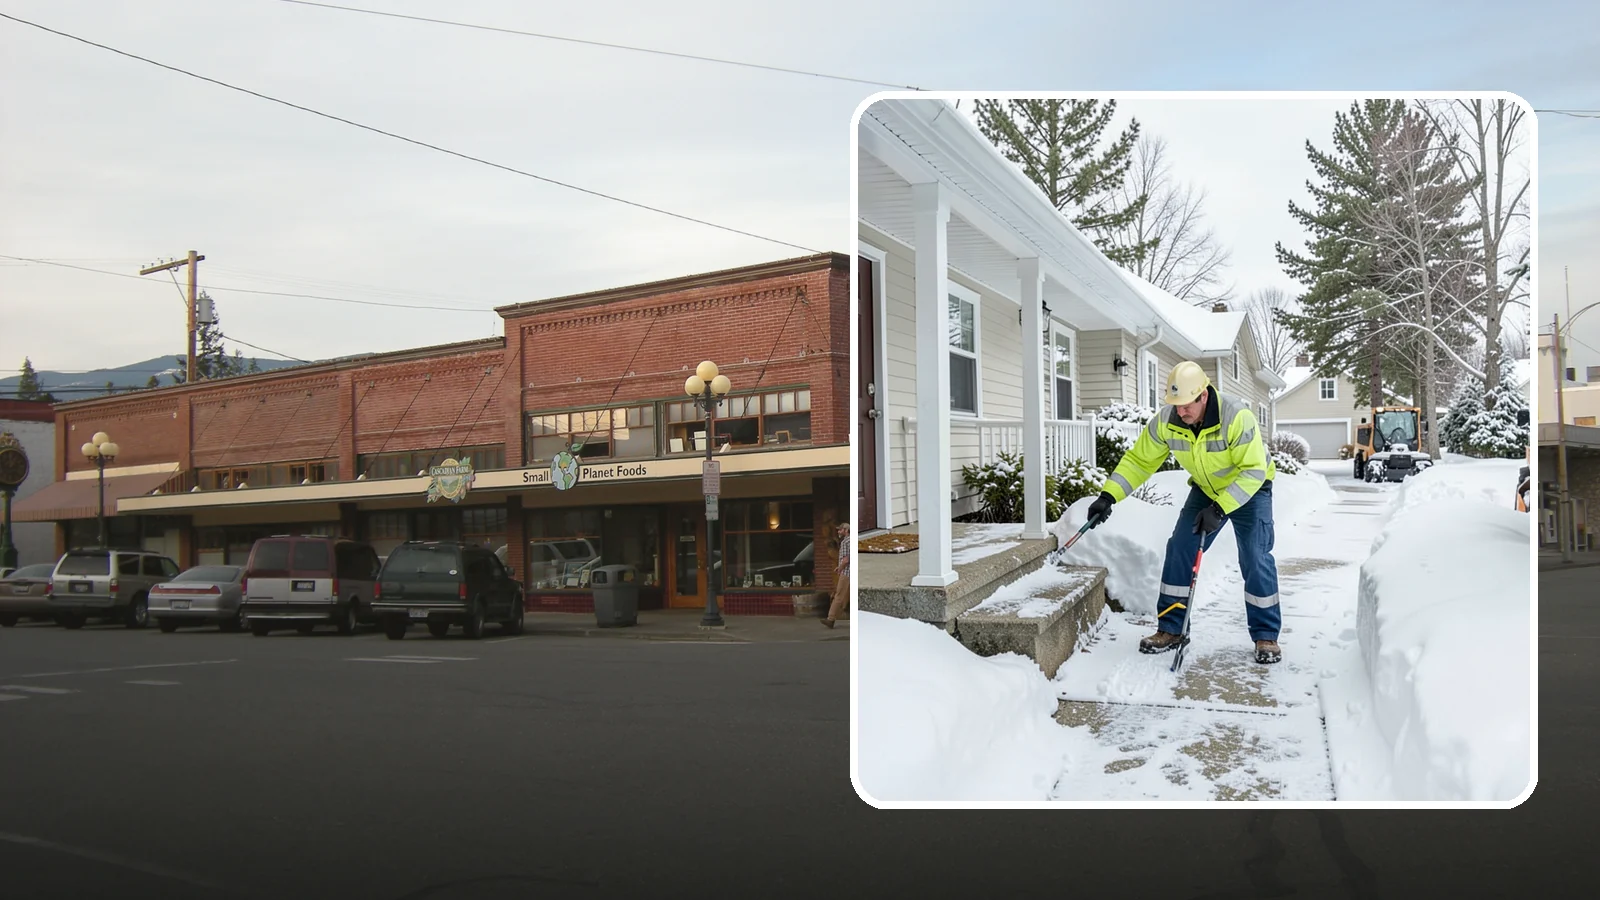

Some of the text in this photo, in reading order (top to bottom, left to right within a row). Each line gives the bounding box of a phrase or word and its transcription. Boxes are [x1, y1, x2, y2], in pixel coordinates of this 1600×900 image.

[523, 464, 647, 482] Small Planet Foods
